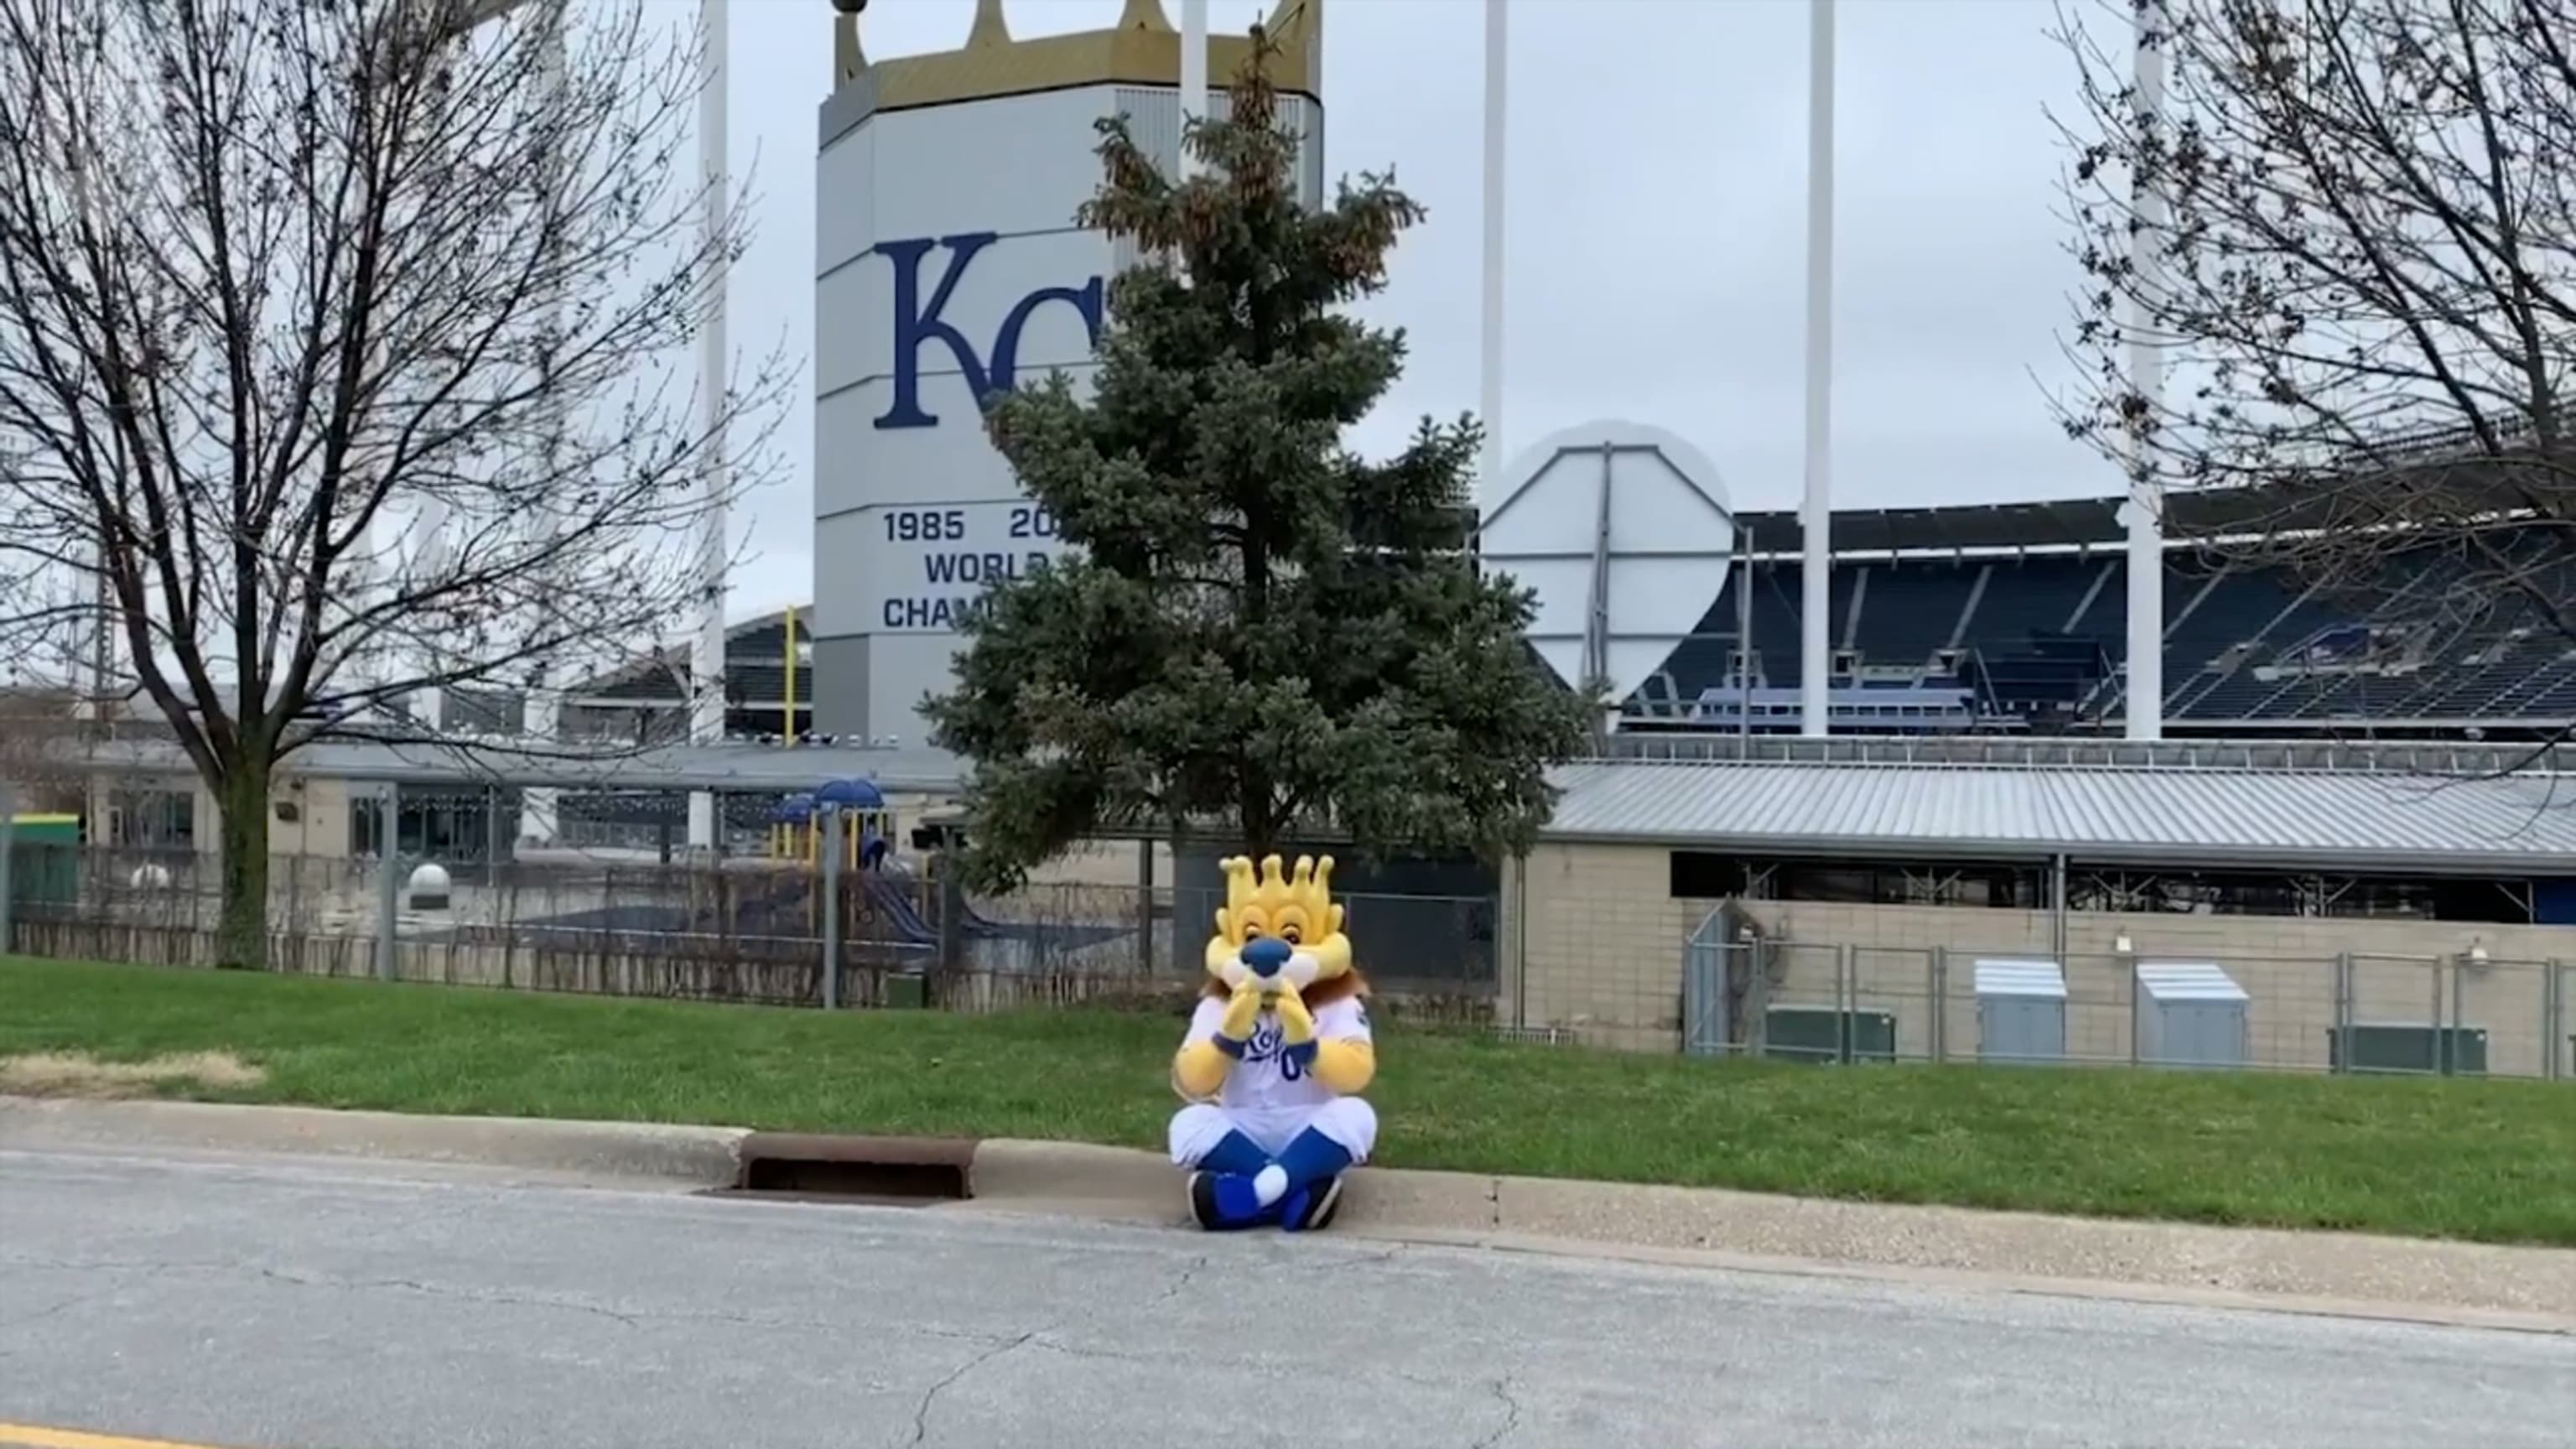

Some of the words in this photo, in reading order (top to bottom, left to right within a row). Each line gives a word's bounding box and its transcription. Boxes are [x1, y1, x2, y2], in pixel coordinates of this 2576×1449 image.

[884, 511, 964, 541] 1985
[1010, 508, 1054, 538] 20
[1244, 1021, 1285, 1063] Roy
